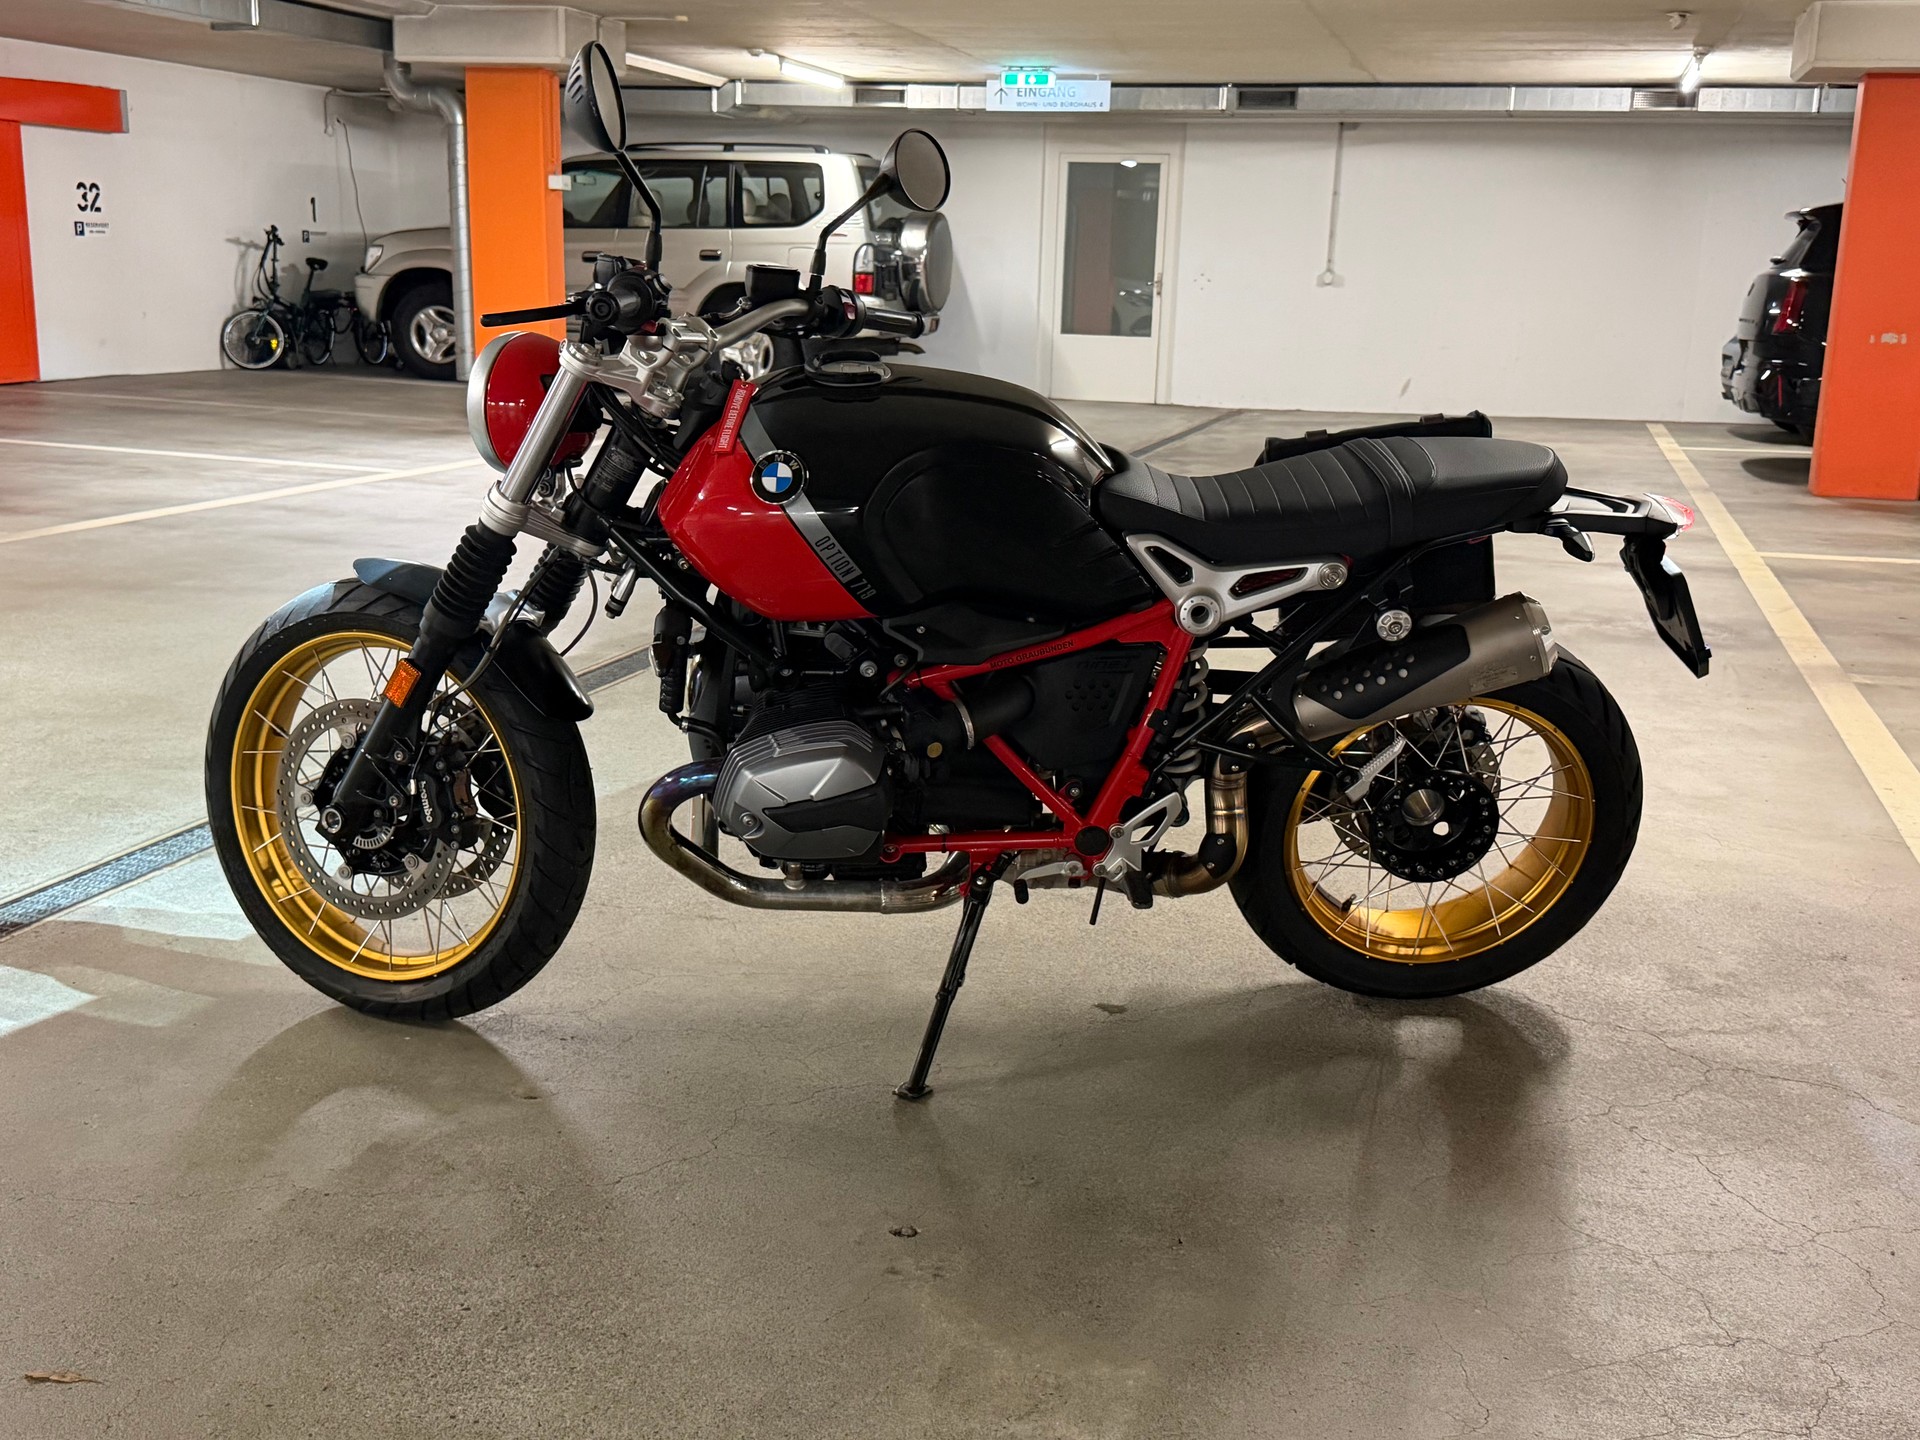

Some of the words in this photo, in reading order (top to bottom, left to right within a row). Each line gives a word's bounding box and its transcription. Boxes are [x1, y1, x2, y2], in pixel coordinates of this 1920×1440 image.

[1016, 86, 1076, 98] EINGANG
[76, 182, 101, 212] 32
[310, 197, 317, 223] 1
[731, 388, 747, 410] REMOVE
[724, 409, 739, 429] BEFORE
[718, 429, 732, 449] FLIGHT
[758, 454, 800, 470] BMW
[815, 535, 856, 578] OPTION
[850, 578, 877, 600] 719
[990, 656, 1015, 669] MOTO
[419, 780, 433, 823] brembo
